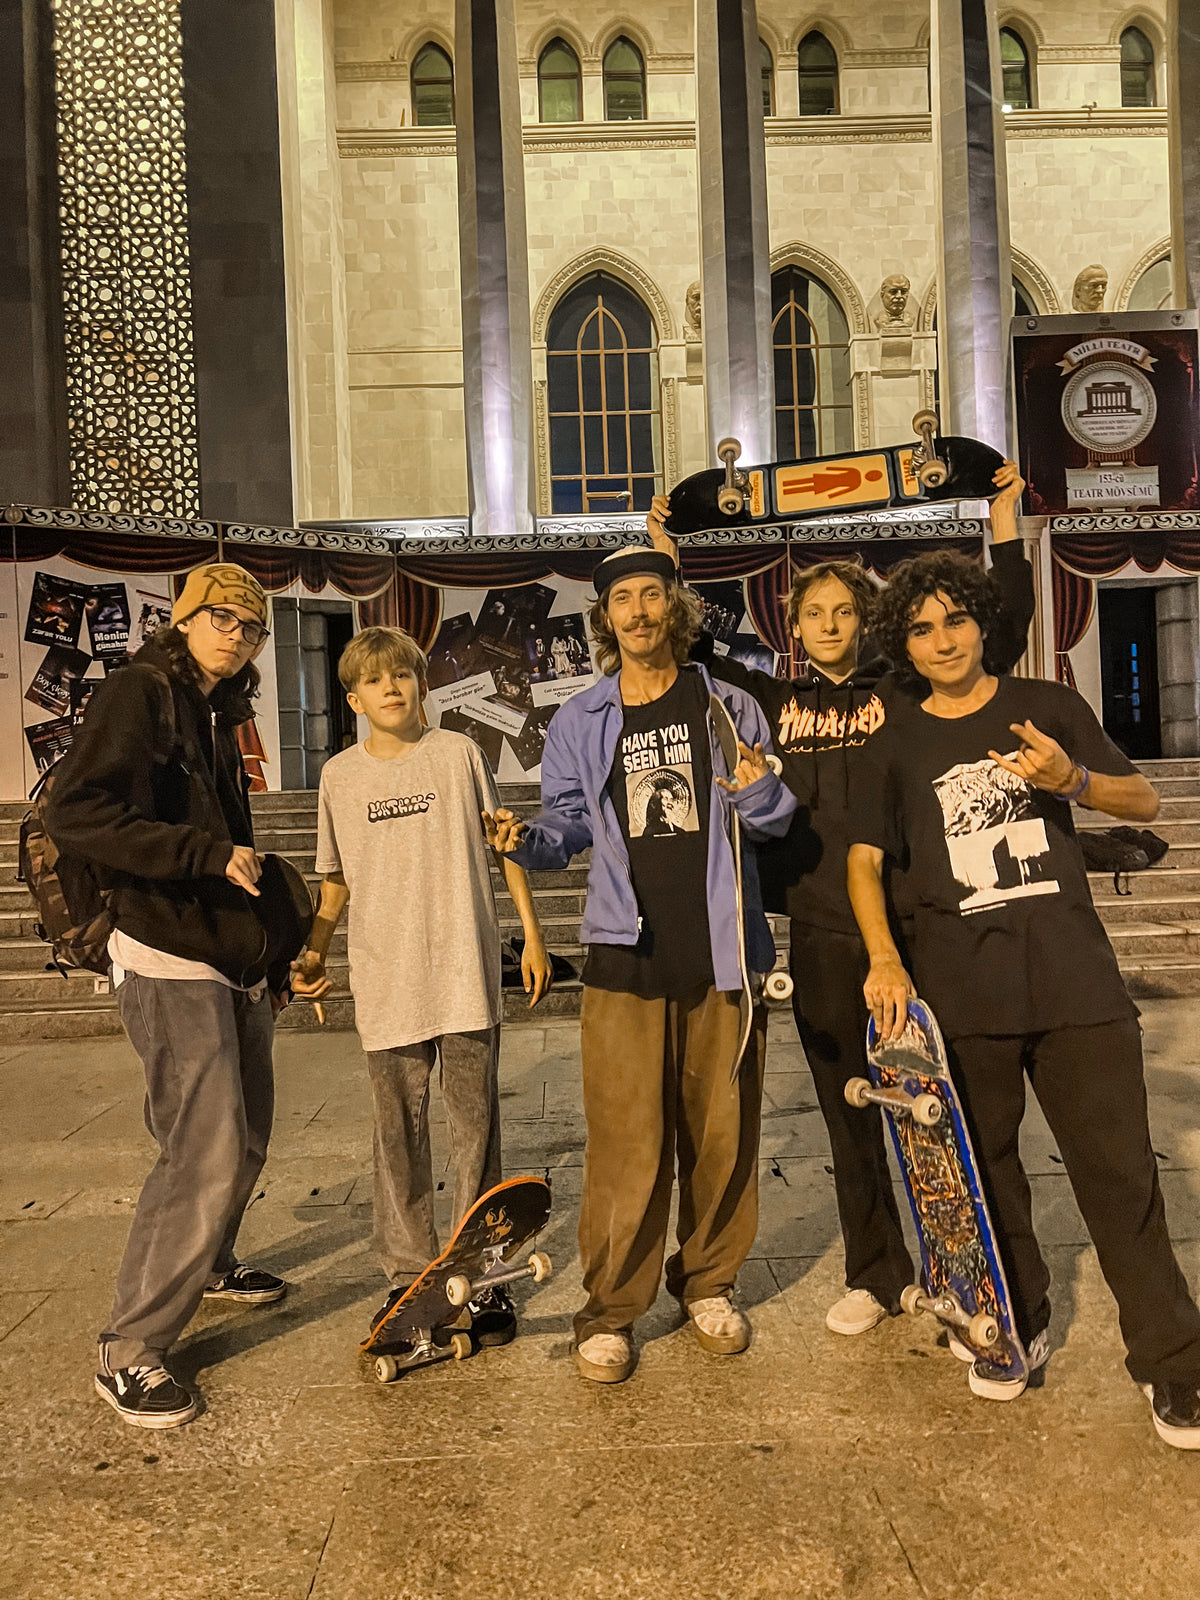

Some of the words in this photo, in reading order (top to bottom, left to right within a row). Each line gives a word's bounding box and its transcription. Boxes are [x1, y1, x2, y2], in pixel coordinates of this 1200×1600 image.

[1106, 340, 1141, 355] TEATR
[1073, 488, 1104, 498] TEATR
[622, 729, 658, 753] HAVE
[659, 723, 689, 745] YOU
[623, 749, 660, 774] SEEN
[663, 742, 692, 765] HIM
